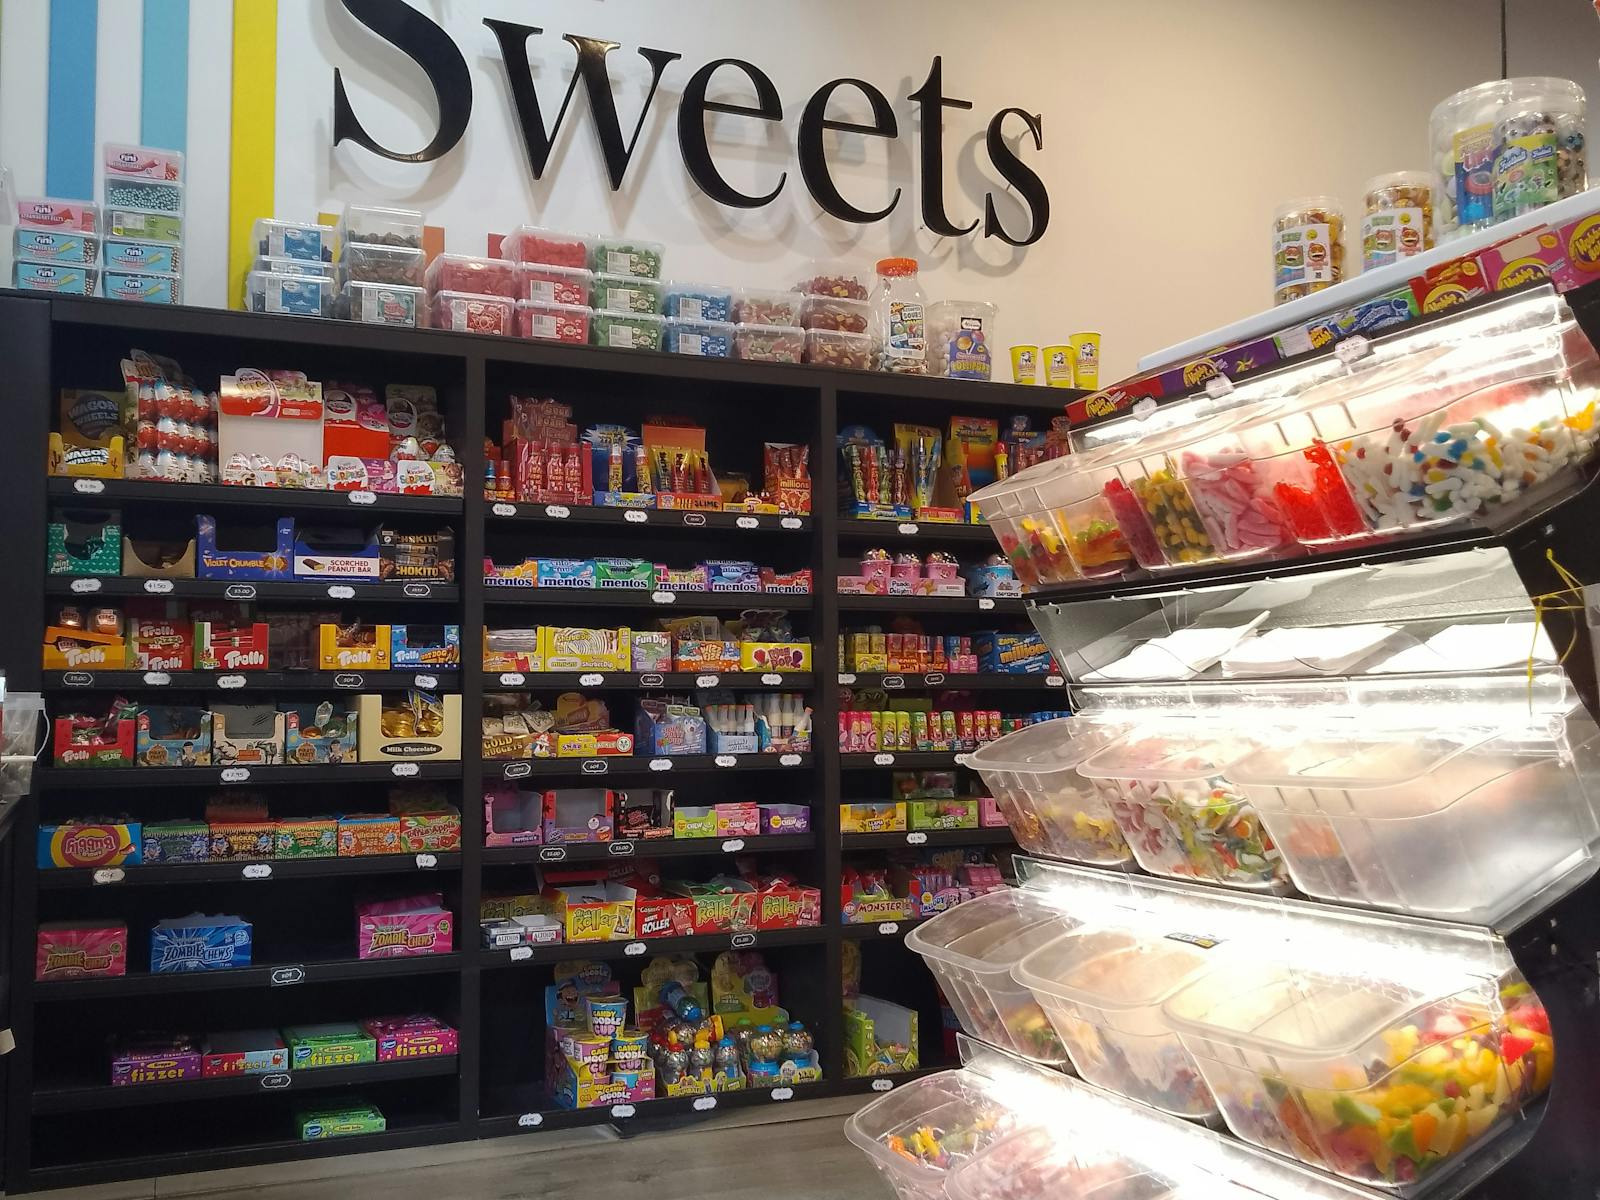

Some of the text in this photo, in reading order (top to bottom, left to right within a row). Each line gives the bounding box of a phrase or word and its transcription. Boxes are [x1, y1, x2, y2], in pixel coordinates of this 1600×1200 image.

[334, 0, 1050, 246] Sweets
[36, 236, 53, 245] Fini
[126, 248, 143, 257] Fini
[38, 269, 55, 278] Fini
[126, 280, 142, 290] Fini
[63, 449, 109, 462] WAGON
[694, 499, 720, 508] SLIME
[203, 558, 265, 568] VIOLET CRUMBLE
[329, 559, 370, 567] SCORCHED
[484, 577, 532, 587] mentos
[543, 577, 591, 587] mentos
[601, 578, 647, 588] mentos
[658, 582, 704, 591] mentos
[713, 583, 757, 592] mentos
[766, 584, 809, 594] mentos
[140, 626, 175, 637] Trolli
[635, 634, 668, 647] Fun Dip
[65, 648, 105, 666] Trolli
[224, 650, 264, 666] Trolli
[338, 650, 371, 666] Trolli
[395, 650, 419, 662] Trolli
[432, 650, 447, 659] DOG
[149, 656, 182, 670] Trolli
[769, 656, 793, 671] POP
[483, 737, 513, 748] GOLD
[484, 743, 523, 757] NUGGETS
[62, 750, 88, 763] Trolli
[686, 822, 703, 830] CHEW
[729, 821, 745, 829] CHEW
[781, 818, 796, 826] CHEW
[696, 898, 739, 927] Roller
[762, 895, 803, 923] Roller
[858, 901, 902, 913] MONSTER
[572, 908, 617, 935] Roller
[641, 919, 670, 934] ROLLER
[372, 931, 435, 948] ZOMBIE CHEWS
[165, 944, 233, 962] ZOMBIE CHEWS
[48, 952, 111, 969] ZOMBIE CHEWS
[592, 1017, 622, 1025] NOODLE
[594, 1024, 616, 1036] CUP
[396, 1043, 443, 1057] fizzer
[614, 1051, 646, 1060] NOODLE
[310, 1052, 360, 1066] fizzer
[619, 1060, 642, 1070] CUP
[223, 1059, 268, 1072] fizzer
[131, 1067, 185, 1083] fizzer
[600, 1092, 632, 1102] NOODLE
